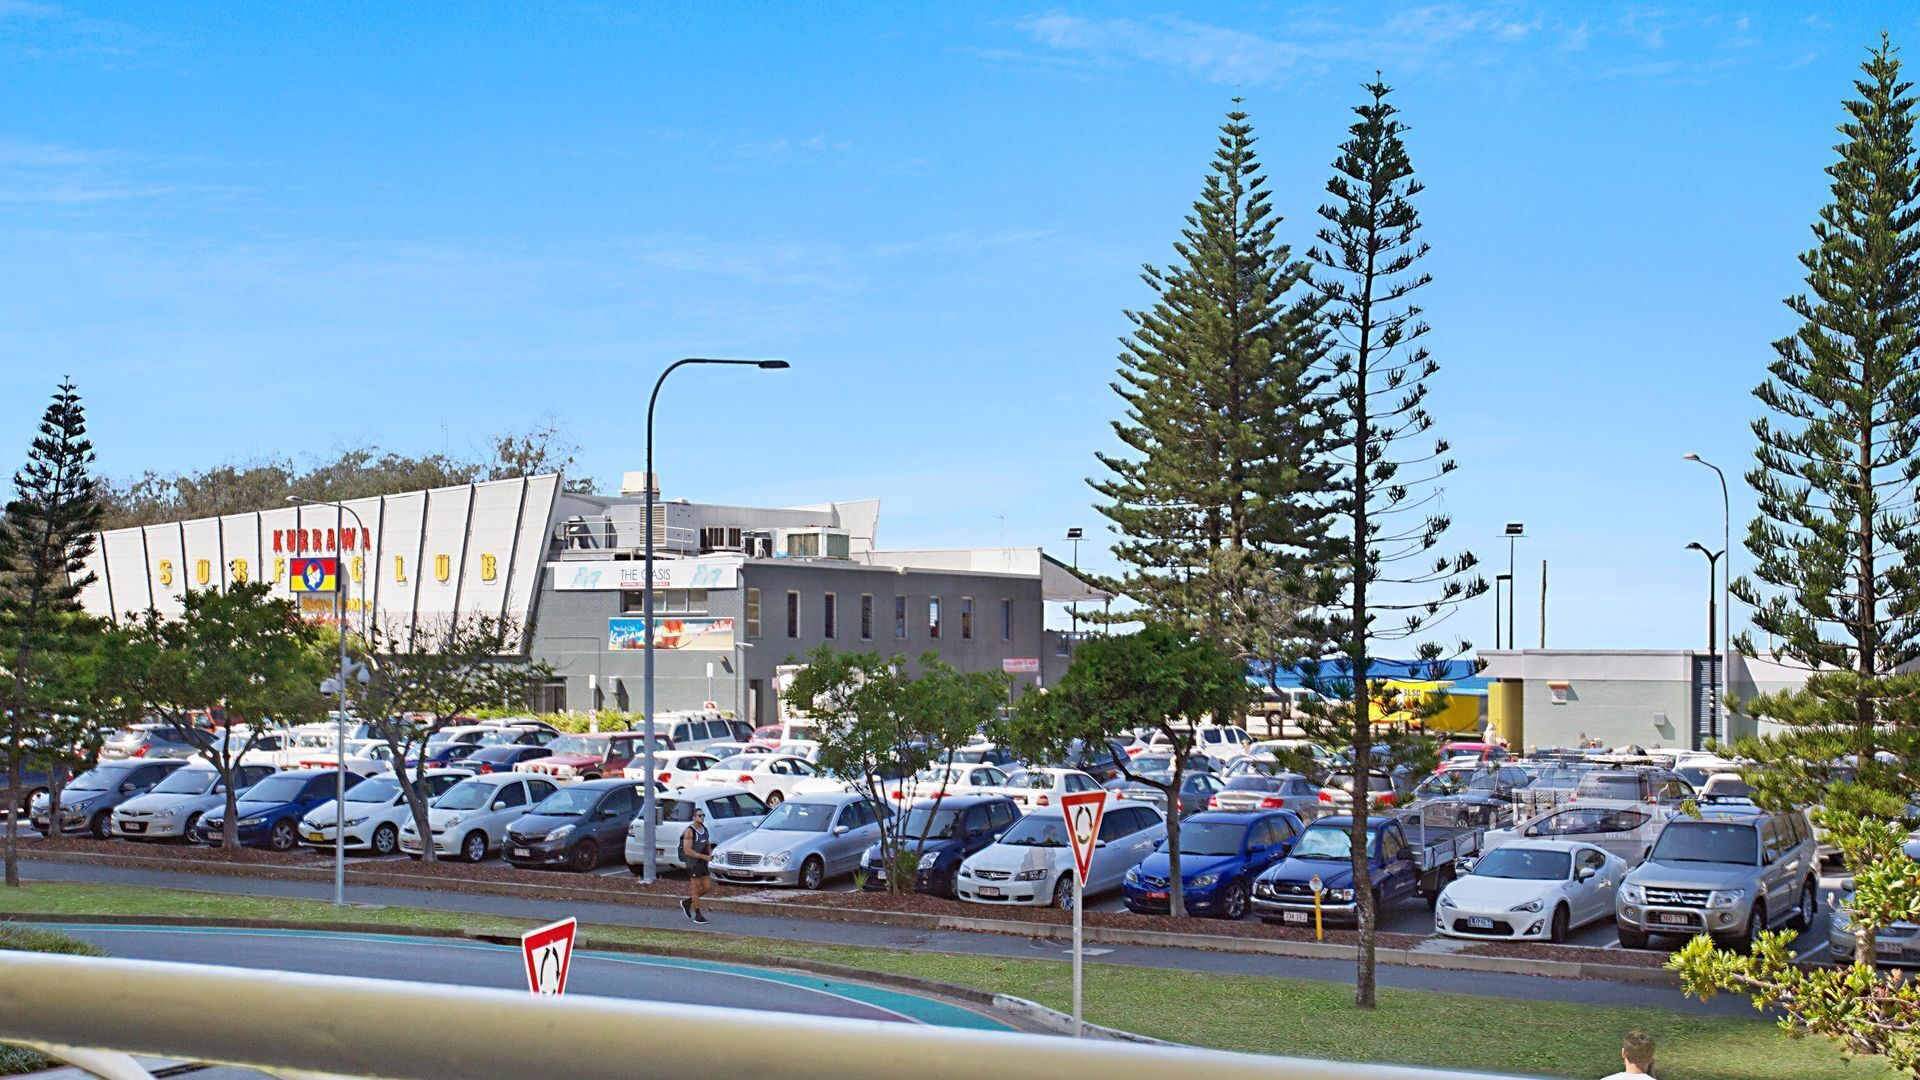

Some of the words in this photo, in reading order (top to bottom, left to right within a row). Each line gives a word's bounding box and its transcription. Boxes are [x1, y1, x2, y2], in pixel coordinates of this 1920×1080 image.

[273, 527, 371, 553] KURRAWA
[351, 553, 497, 583] CLUB
[620, 569, 638, 580] THE
